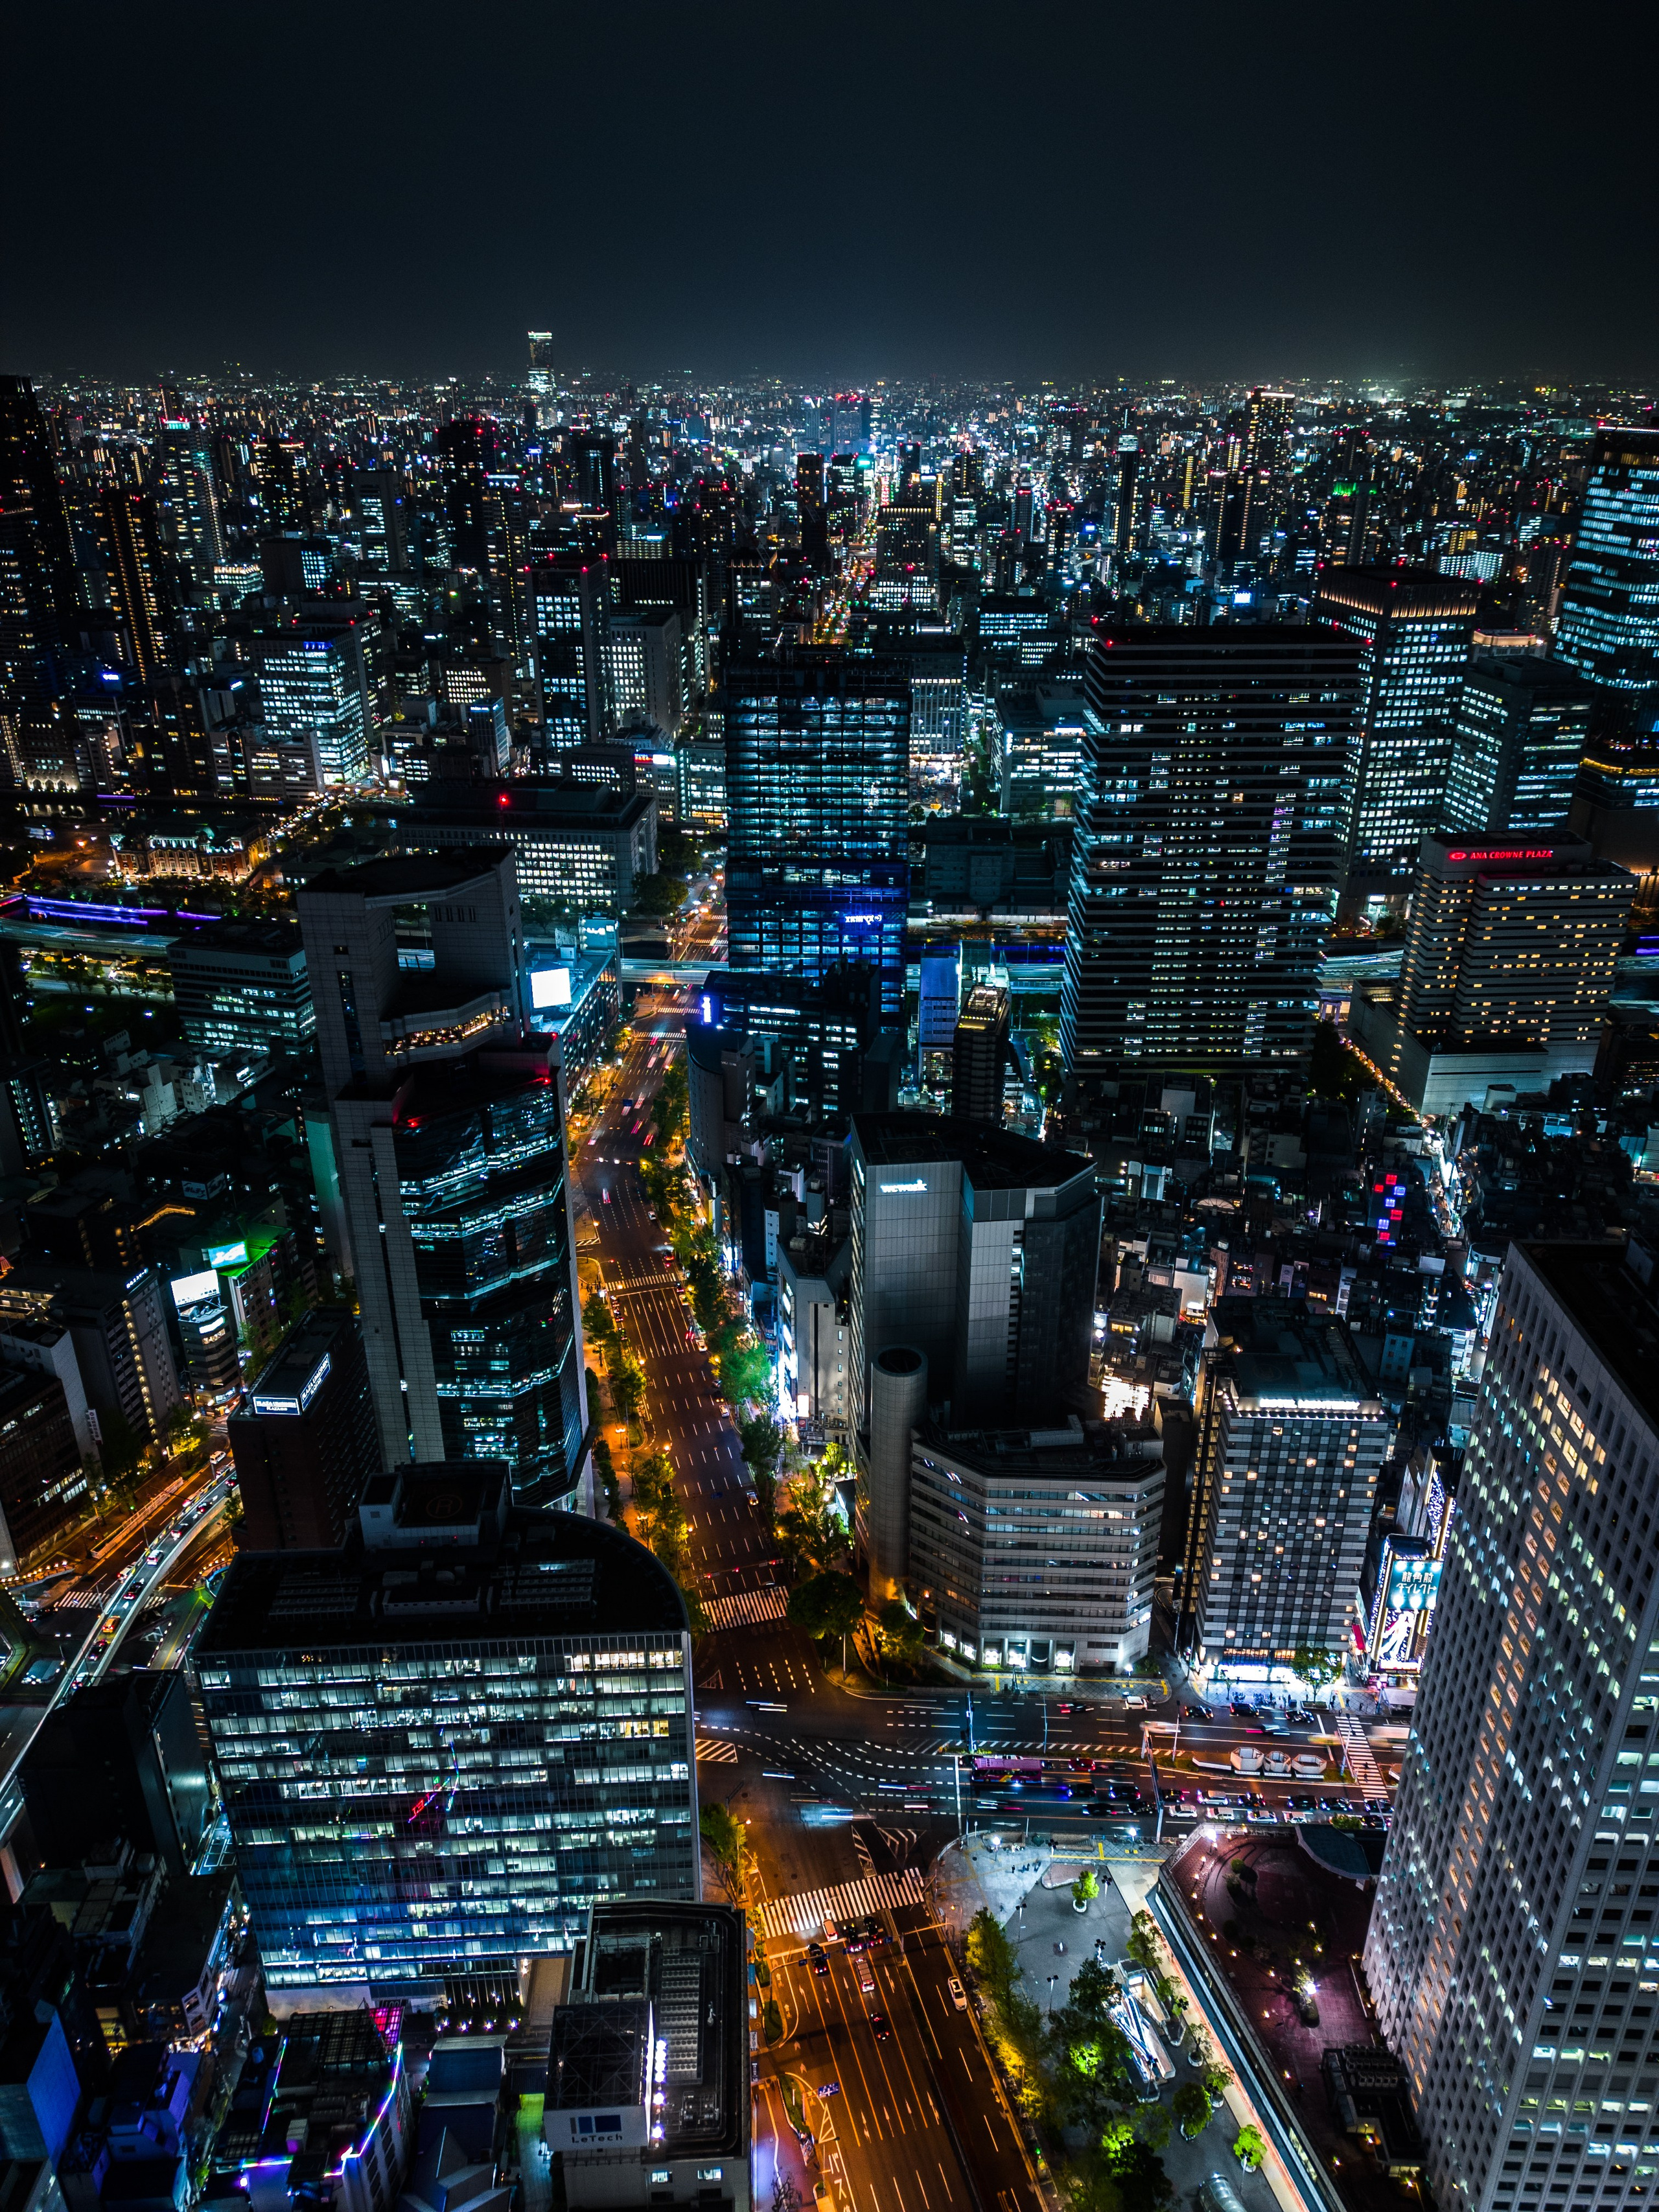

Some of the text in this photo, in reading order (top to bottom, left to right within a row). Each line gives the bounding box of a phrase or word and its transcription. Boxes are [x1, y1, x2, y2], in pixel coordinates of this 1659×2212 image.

[1526, 850, 1552, 858] PLAZA
[1402, 1571, 1434, 1583] 龍角散
[1395, 1583, 1437, 1594] ダイレクト
[572, 2133, 623, 2143] LeTech
